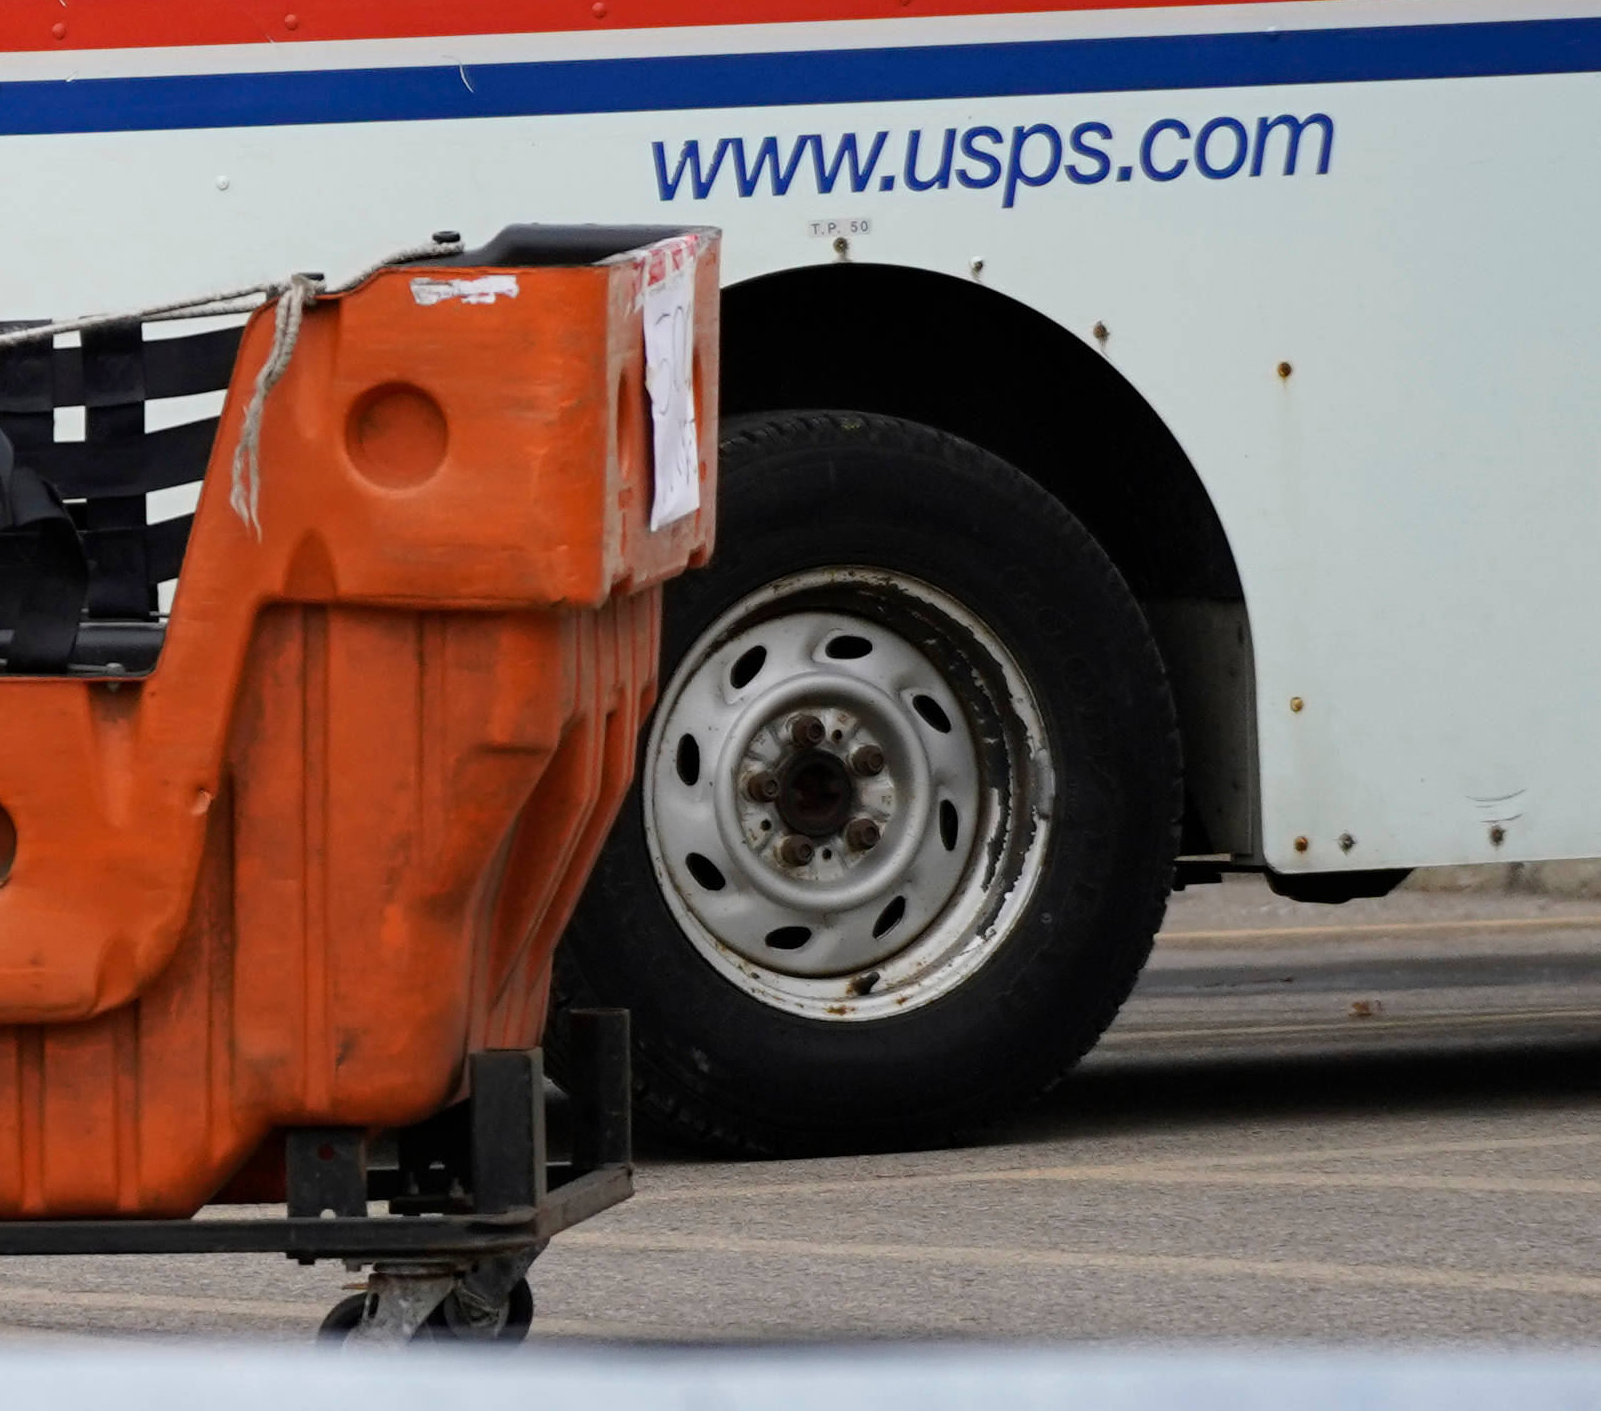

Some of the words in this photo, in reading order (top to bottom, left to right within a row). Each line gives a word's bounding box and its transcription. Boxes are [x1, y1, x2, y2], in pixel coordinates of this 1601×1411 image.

[650, 111, 1336, 209] www.usps.com
[811, 222, 840, 235] T.P.
[850, 220, 869, 233] 50
